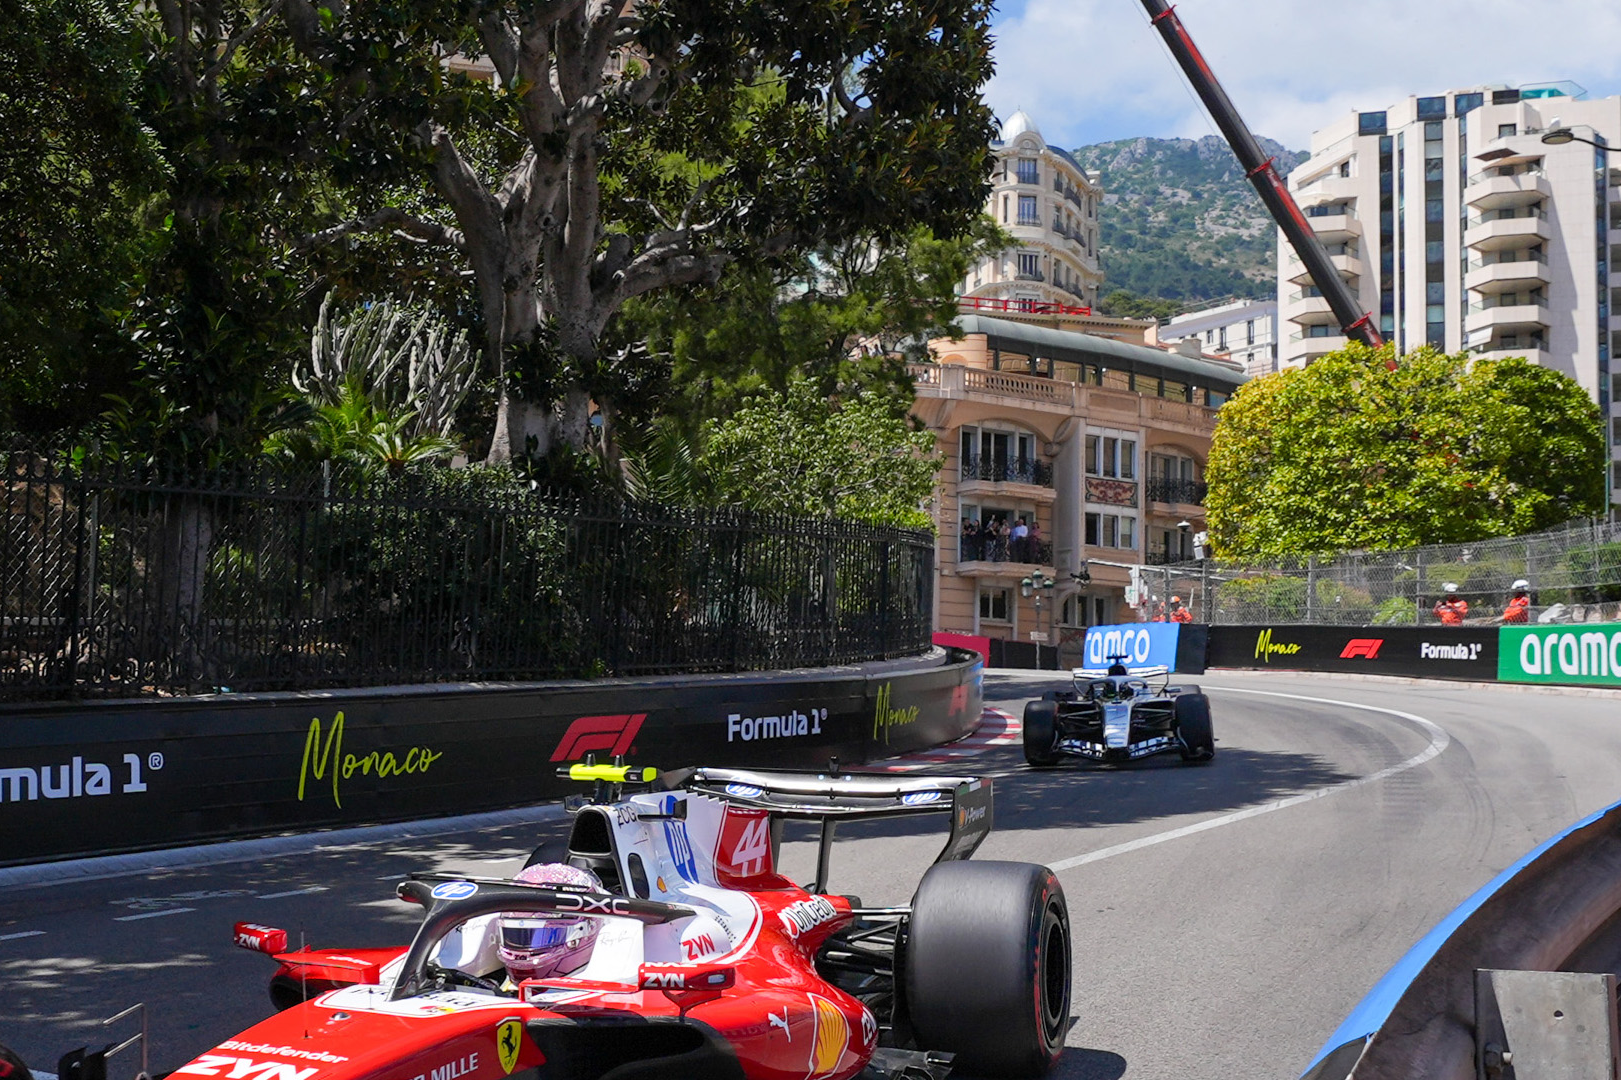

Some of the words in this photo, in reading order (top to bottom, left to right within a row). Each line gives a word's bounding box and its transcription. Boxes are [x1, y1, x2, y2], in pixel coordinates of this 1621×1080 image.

[1254, 628, 1302, 663] Monaco
[1338, 638, 1384, 659] F1
[1421, 642, 1469, 660] Formula
[728, 710, 808, 742] Formula
[874, 681, 920, 745] Monaco
[549, 714, 648, 762] F1
[297, 710, 443, 809] Monaco
[731, 816, 768, 878] 44
[555, 893, 630, 915] DXC
[238, 933, 261, 950] ZYN
[682, 933, 716, 962] ZYN
[644, 973, 684, 988] ZYN
[216, 1040, 349, 1064] Bitdefender
